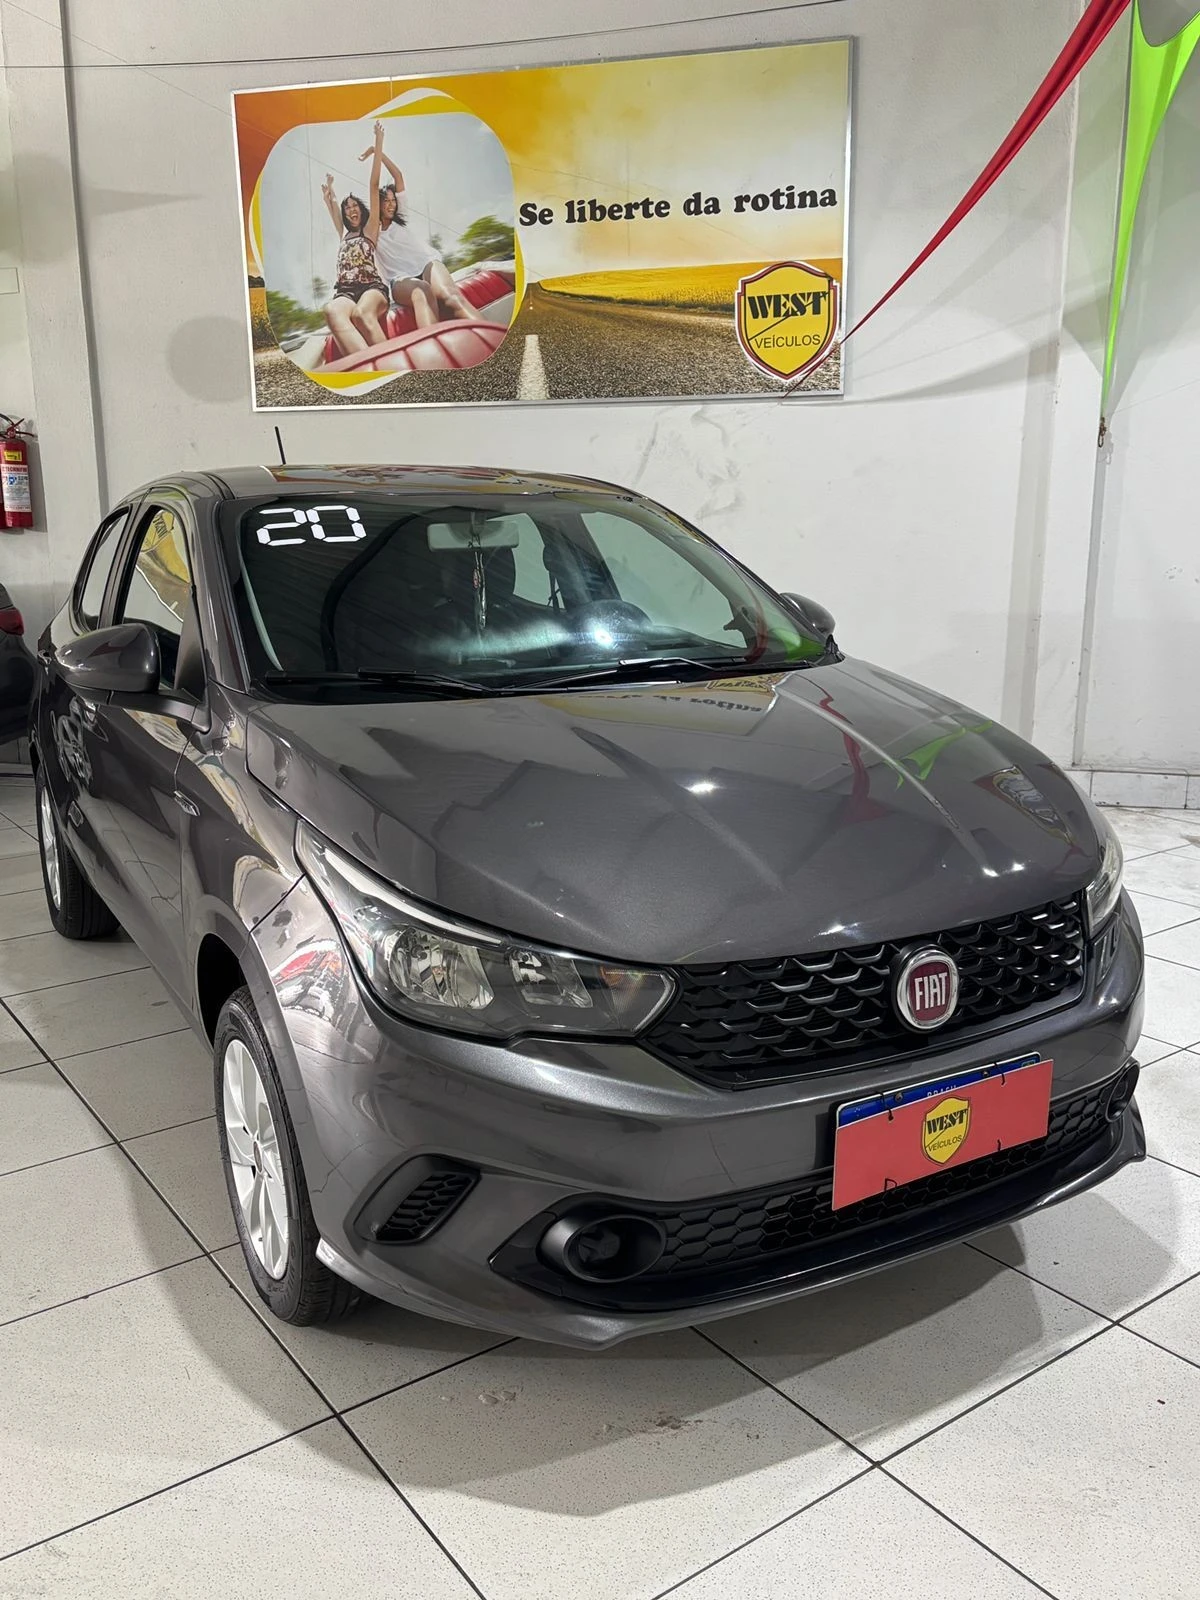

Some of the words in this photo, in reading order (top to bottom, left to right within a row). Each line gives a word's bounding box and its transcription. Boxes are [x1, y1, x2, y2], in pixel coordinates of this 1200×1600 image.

[519, 202, 553, 227] Se
[565, 197, 671, 223] liberte
[683, 192, 721, 216] da
[734, 185, 838, 213] rotina
[748, 290, 827, 319] WEST
[755, 334, 821, 349] VEÍCULOS
[256, 505, 367, 546] 20
[914, 972, 948, 1011] FIAT
[927, 1108, 968, 1135] WEST
[928, 1135, 963, 1152] VEÍCULOS
